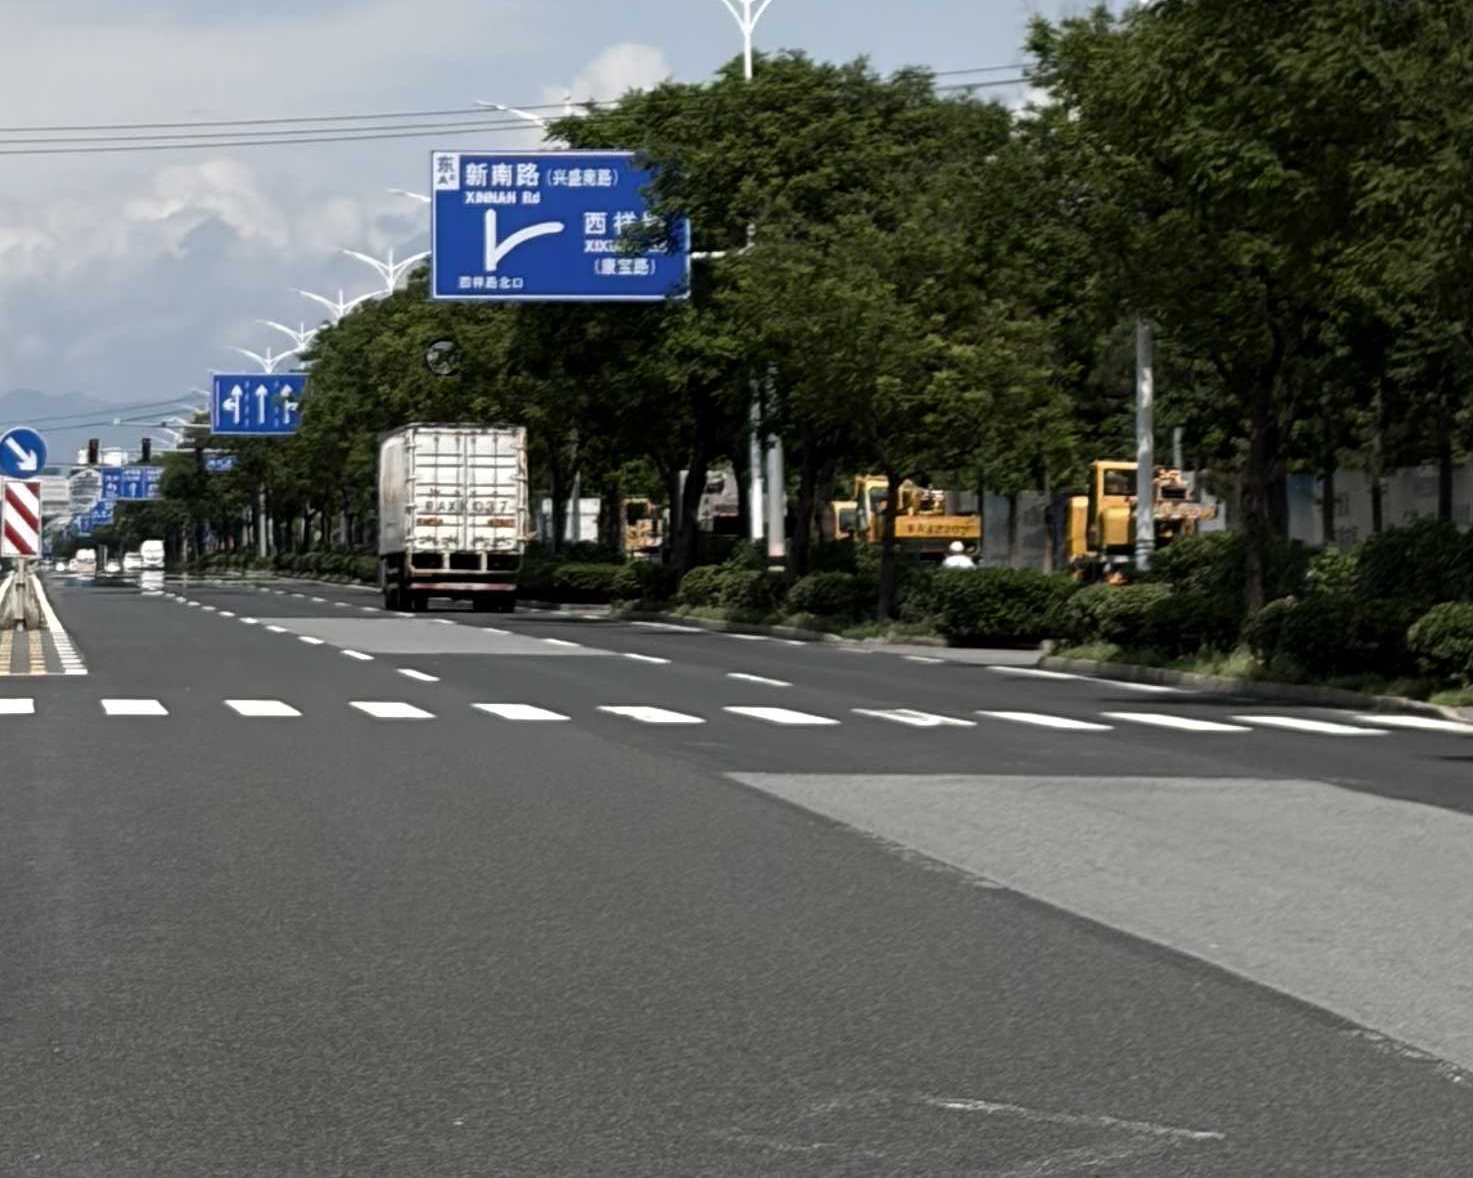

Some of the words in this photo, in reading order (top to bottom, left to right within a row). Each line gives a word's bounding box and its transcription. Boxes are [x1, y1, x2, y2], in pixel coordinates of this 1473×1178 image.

[436, 156, 454, 173] 东
[465, 162, 539, 186] 新南路
